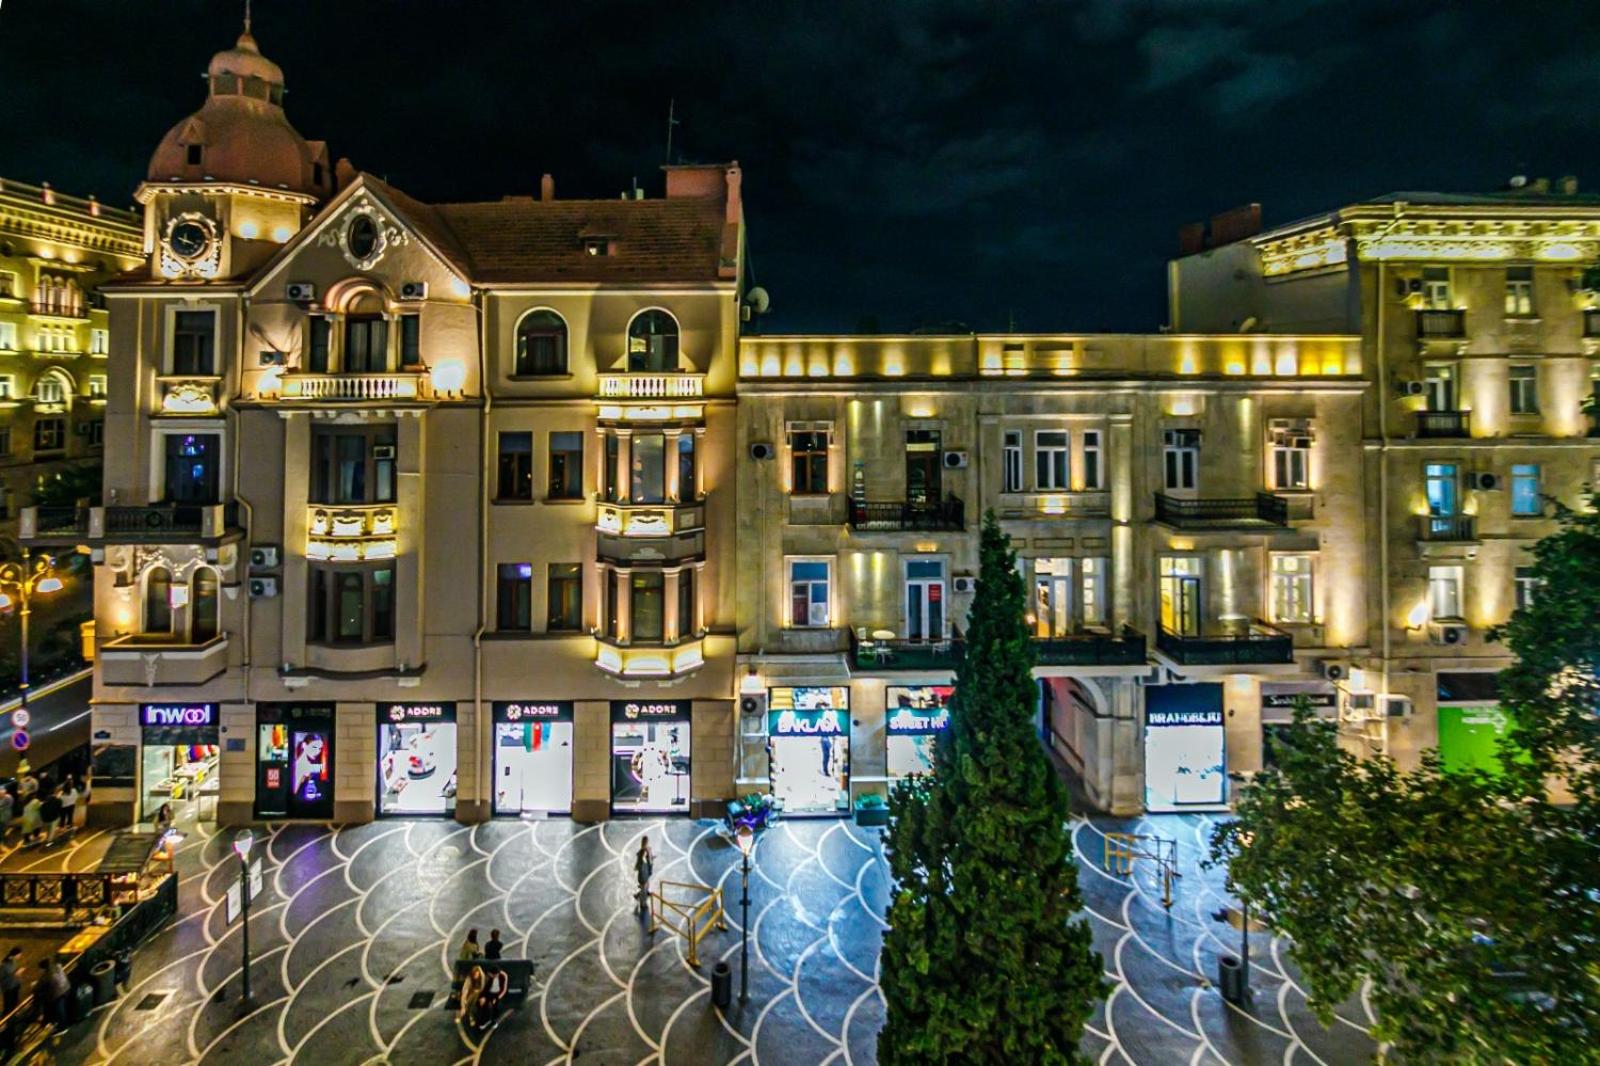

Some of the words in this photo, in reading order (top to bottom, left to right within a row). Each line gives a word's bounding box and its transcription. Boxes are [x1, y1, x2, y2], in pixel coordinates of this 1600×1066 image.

[407, 707, 442, 715] ADORE
[523, 706, 559, 714] ADORE
[640, 705, 677, 714] ADORE
